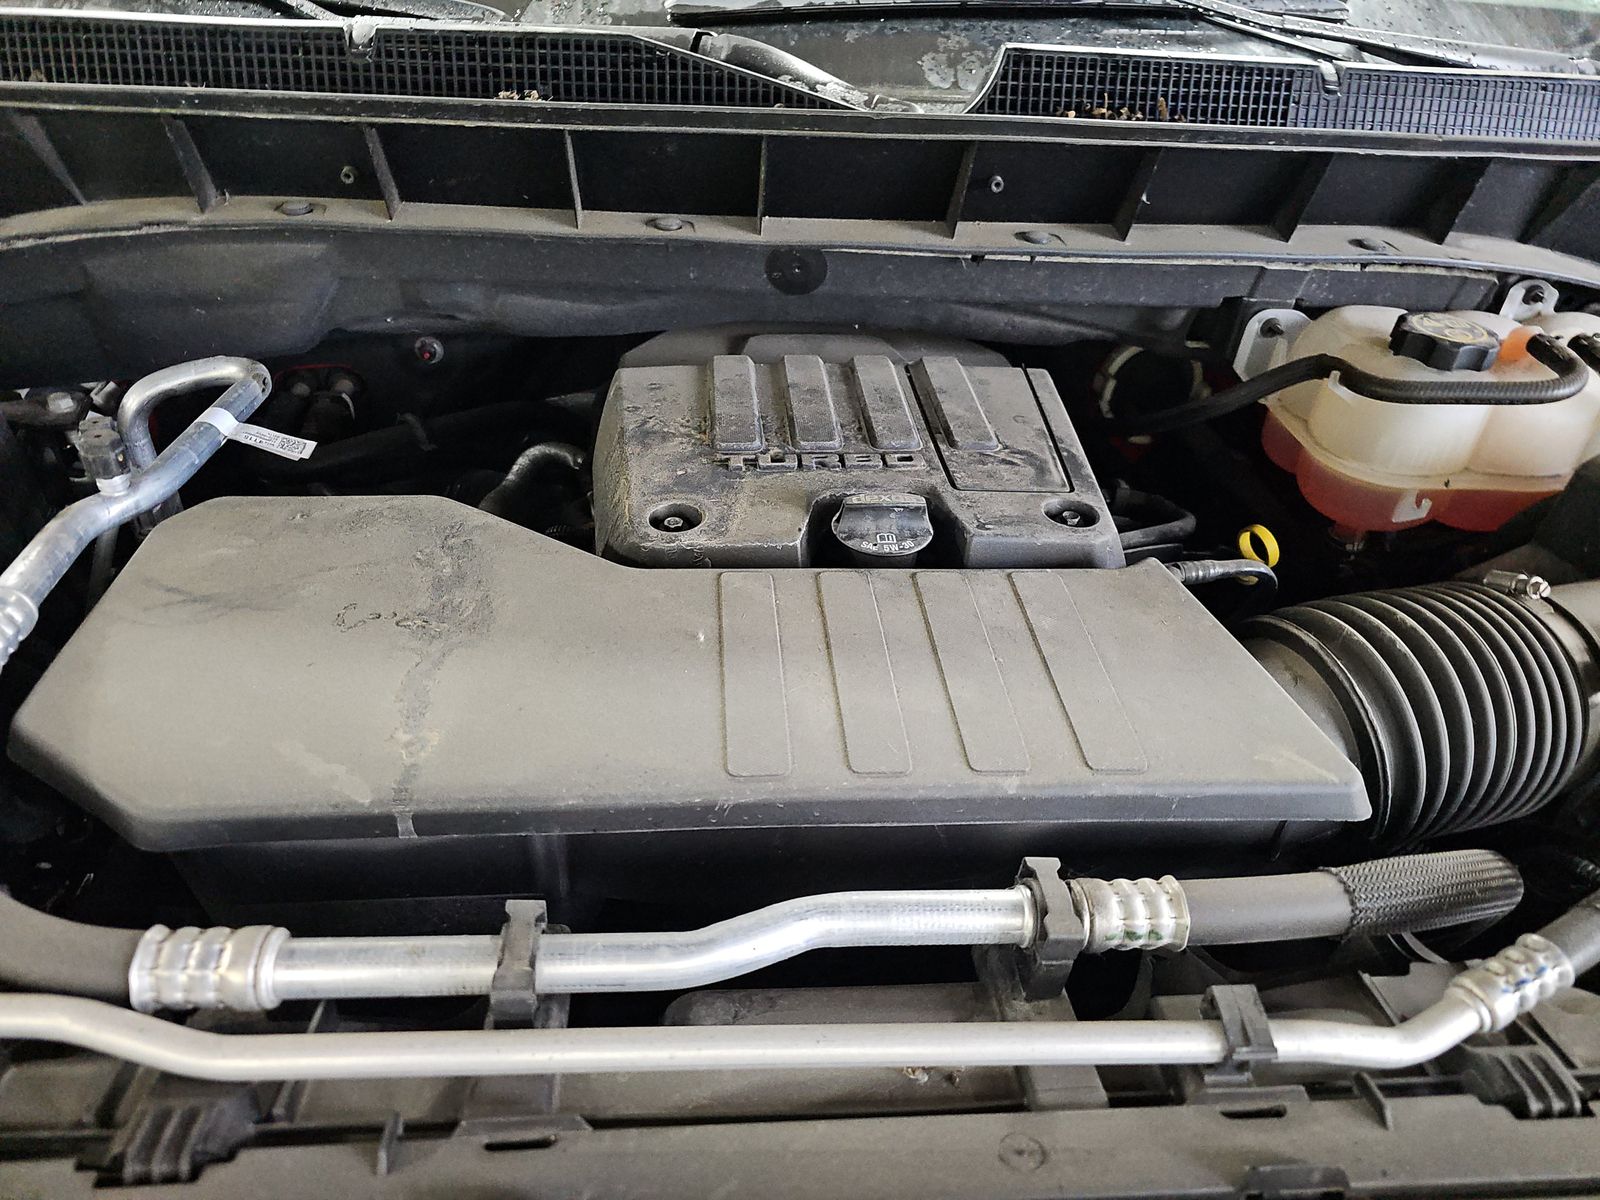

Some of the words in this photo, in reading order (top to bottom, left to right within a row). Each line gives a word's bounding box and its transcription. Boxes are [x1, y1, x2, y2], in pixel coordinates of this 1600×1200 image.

[716, 453, 927, 472] TURBO
[861, 541, 879, 551] SAE
[884, 540, 914, 551] 5W-30
